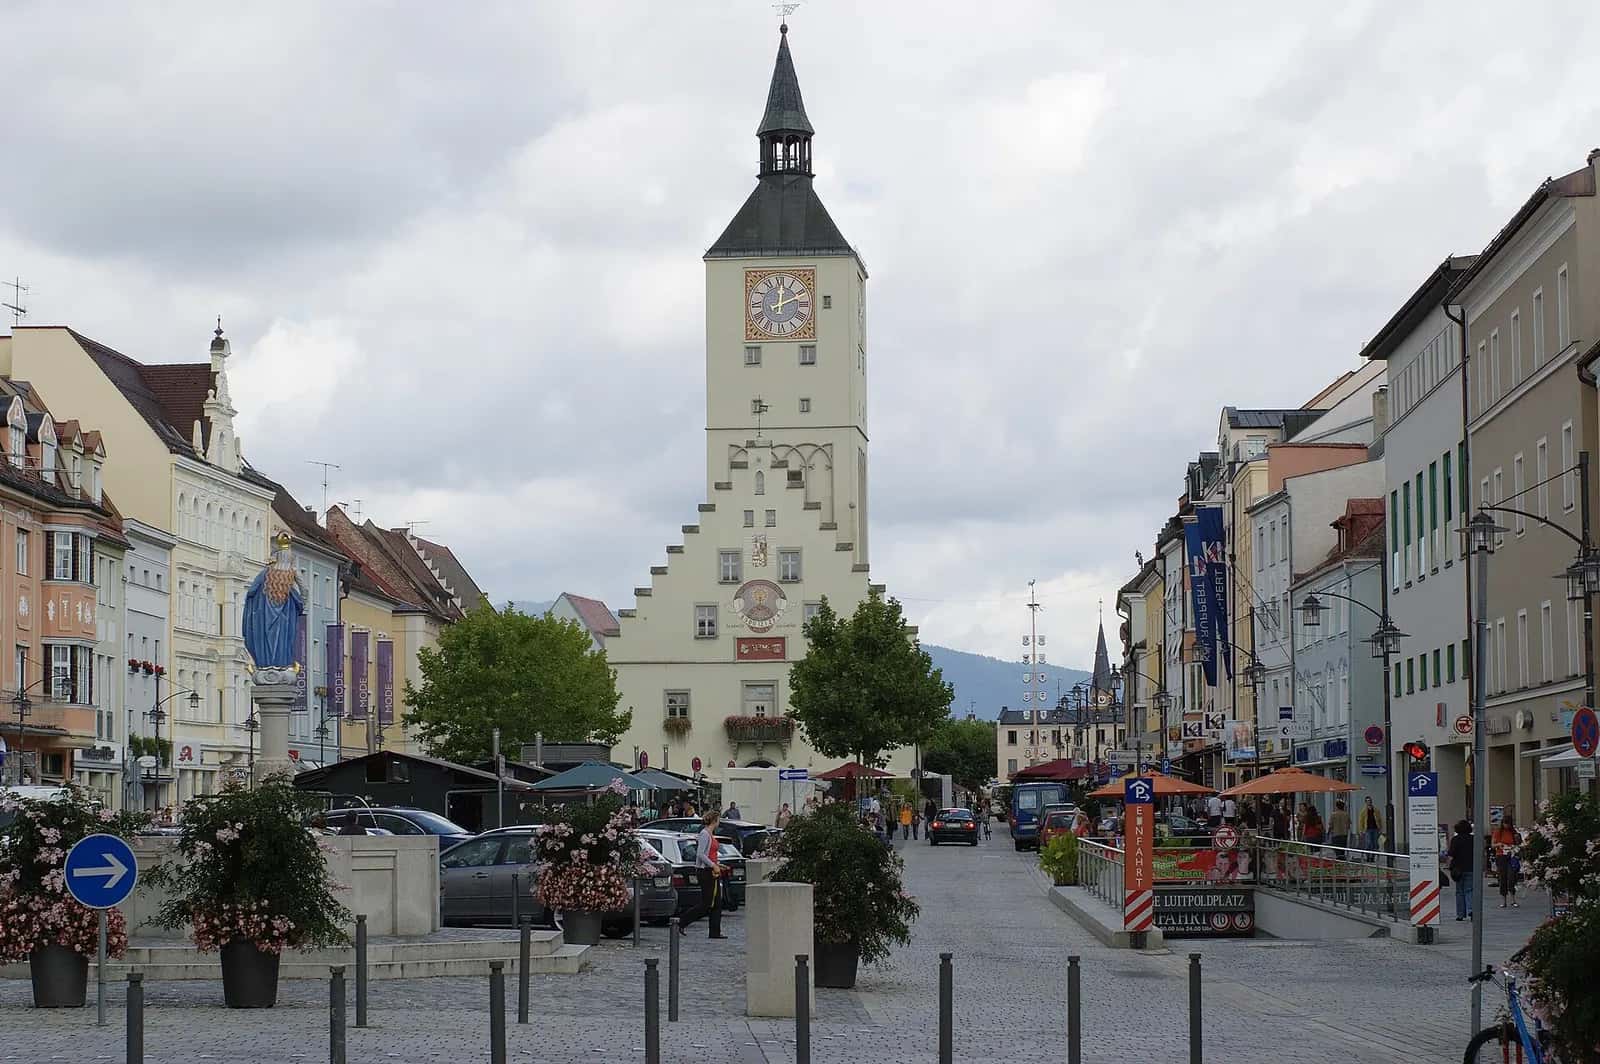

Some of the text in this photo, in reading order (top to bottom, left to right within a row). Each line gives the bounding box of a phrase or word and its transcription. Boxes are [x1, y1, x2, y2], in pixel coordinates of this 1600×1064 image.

[335, 671, 344, 704] MODE
[359, 677, 368, 708] MODE
[384, 683, 393, 713] MODE
[1135, 786, 1145, 799] P
[1419, 780, 1427, 790] P
[1135, 806, 1144, 888] ENFAHRT
[1164, 895, 1246, 908] LUITPOLDPLATZ
